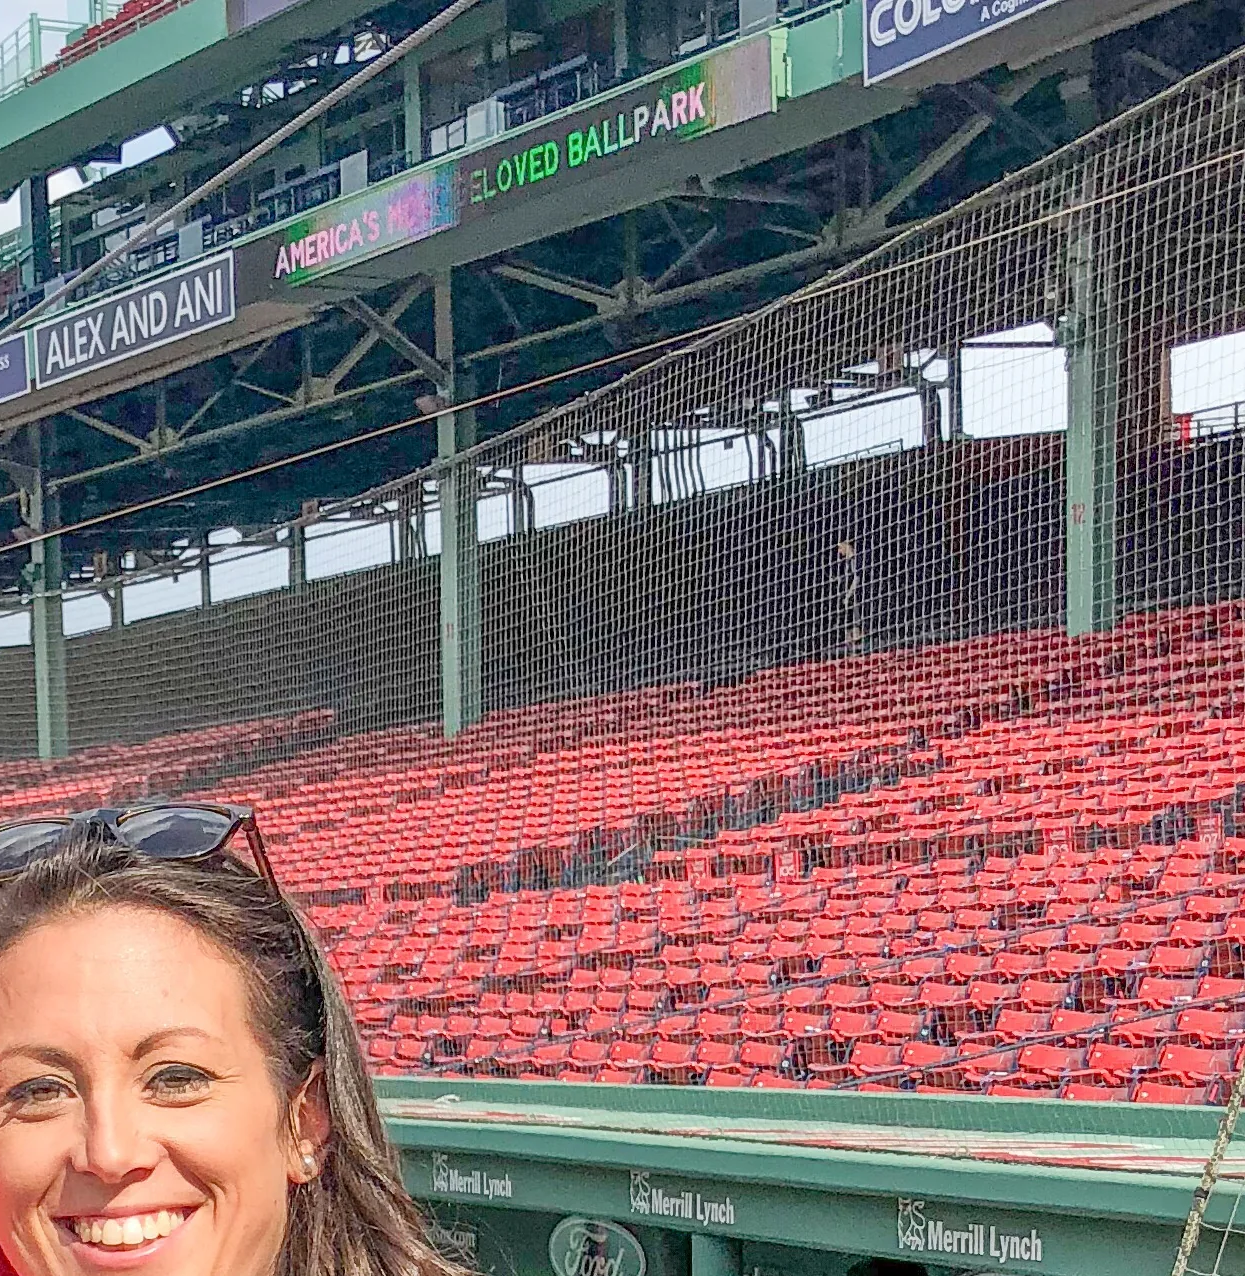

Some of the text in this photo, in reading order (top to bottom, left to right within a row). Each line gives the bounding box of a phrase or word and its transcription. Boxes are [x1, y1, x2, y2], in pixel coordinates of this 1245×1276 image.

[980, 6, 991, 22] A
[469, 82, 706, 205] ELOVED BALLPARK
[275, 209, 380, 279] AMERICA'S
[45, 268, 223, 376] ALEX AND ANI
[449, 1169, 512, 1200] Merrill Lynch
[652, 1188, 735, 1226] Merrill Lynch
[927, 1220, 1043, 1264] Merrill Lynch
